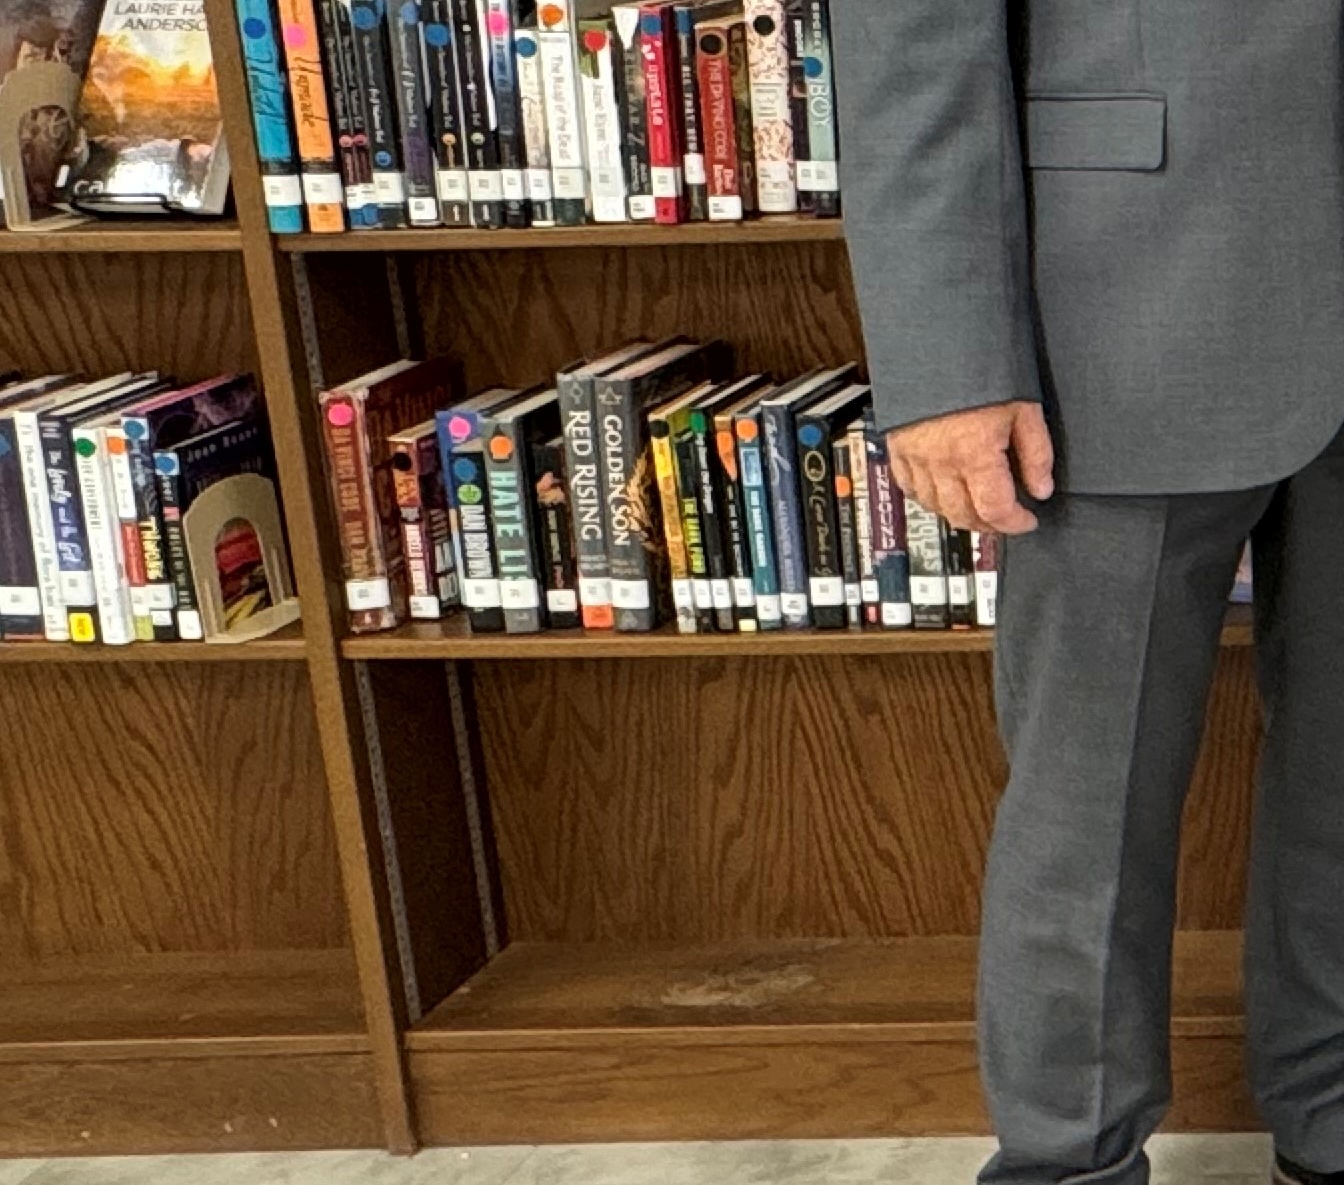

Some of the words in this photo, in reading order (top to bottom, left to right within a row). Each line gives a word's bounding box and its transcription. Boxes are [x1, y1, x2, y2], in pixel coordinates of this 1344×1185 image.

[115, 2, 176, 15] LAURIE
[121, 18, 207, 32] ANDERSO
[566, 410, 594, 456] RED
[603, 415, 627, 498] GOLDEN
[489, 471, 524, 537] HATE
[572, 464, 602, 540] RISING
[611, 505, 634, 546] SON
[501, 550, 530, 581] LIS
